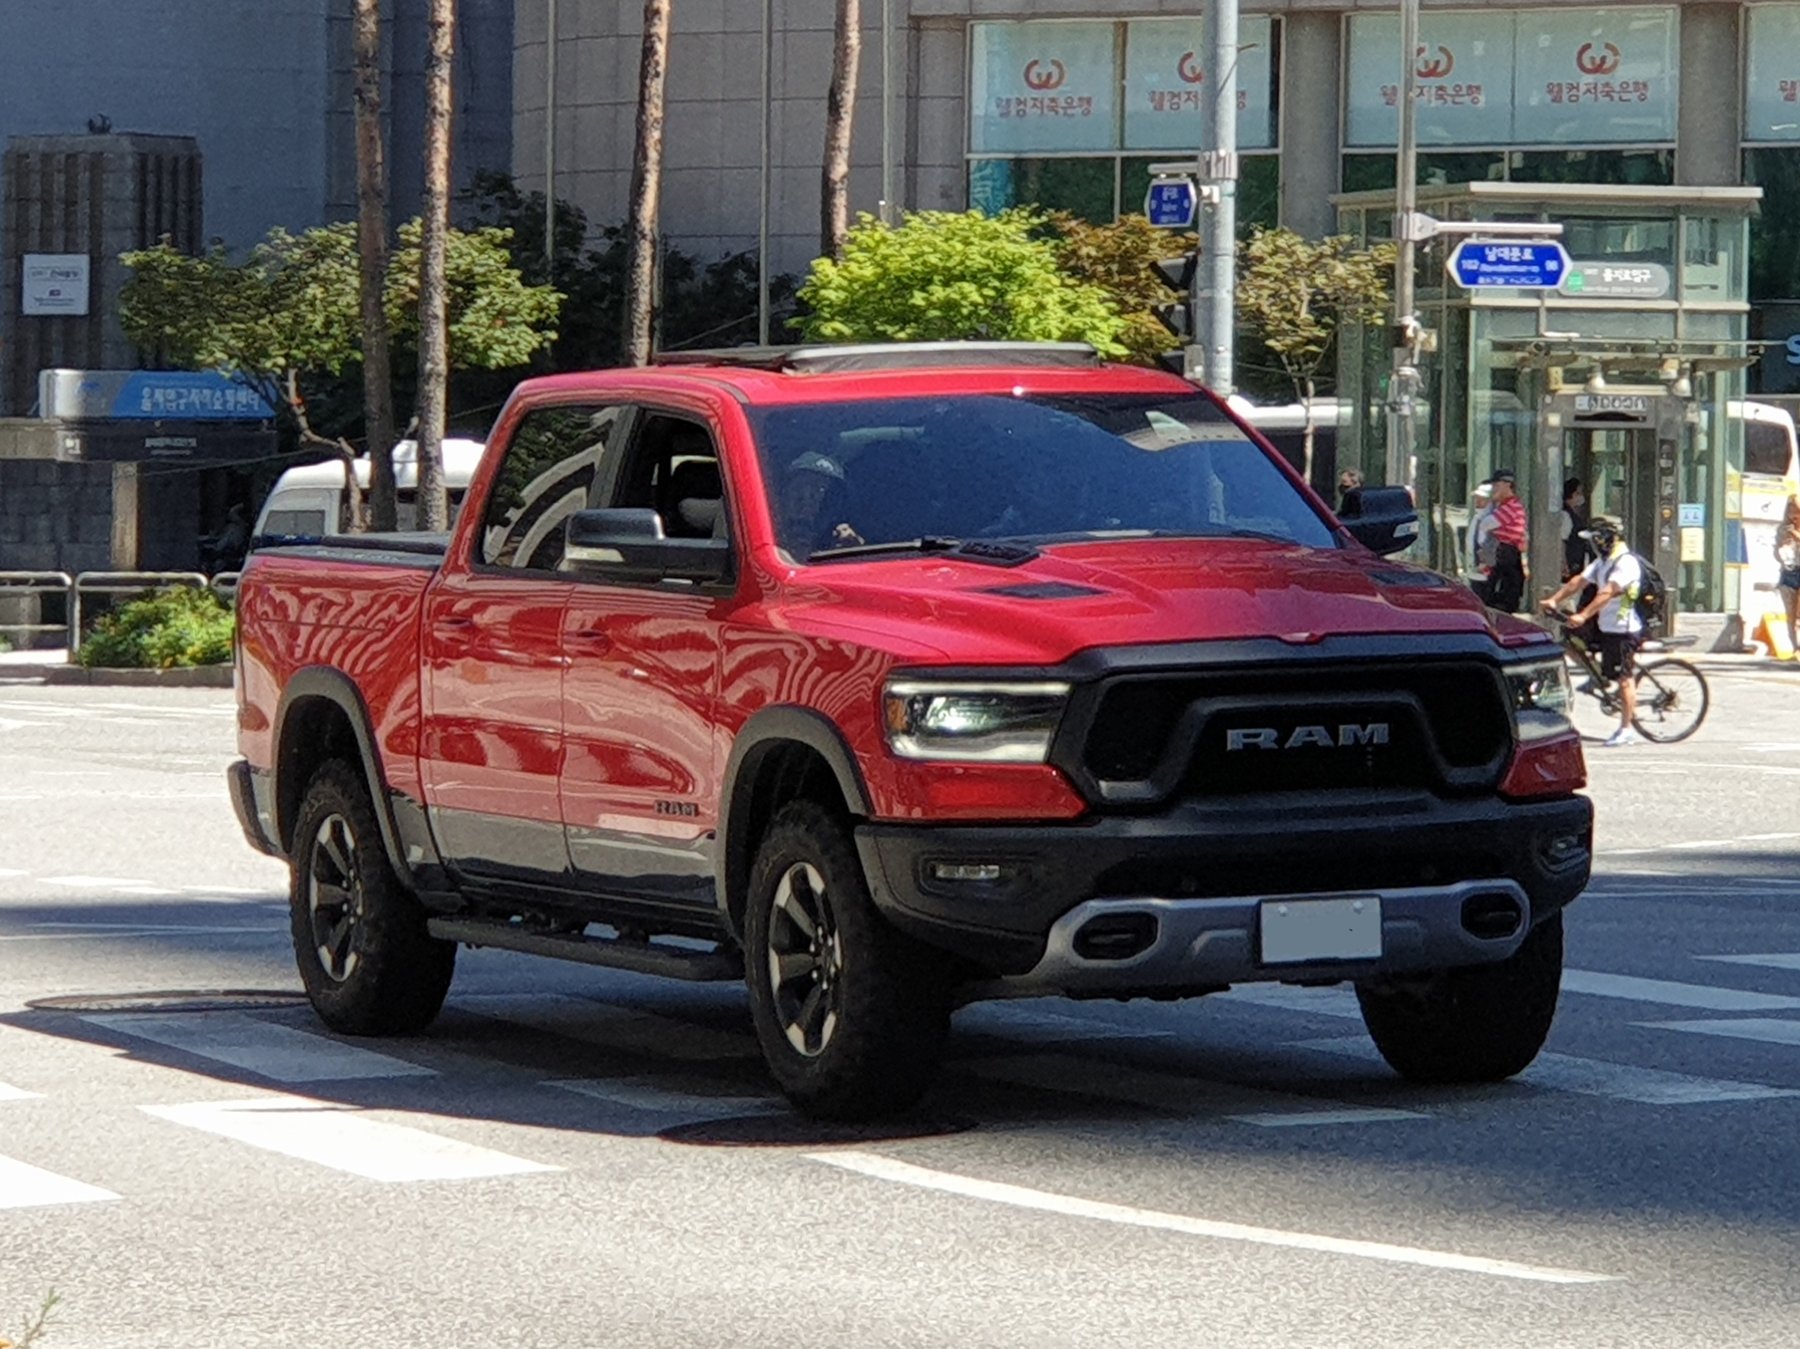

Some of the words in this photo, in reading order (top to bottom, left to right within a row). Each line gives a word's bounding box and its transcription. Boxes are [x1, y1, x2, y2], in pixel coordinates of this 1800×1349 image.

[1379, 84, 1482, 106] 웰저축은행
[1546, 81, 1649, 103] 웰컴저축은행
[996, 96, 1093, 118] 웰컴저축은행
[1484, 246, 1535, 262] 남대문로
[1226, 722, 1390, 751] RAM
[654, 799, 700, 818] RAM
